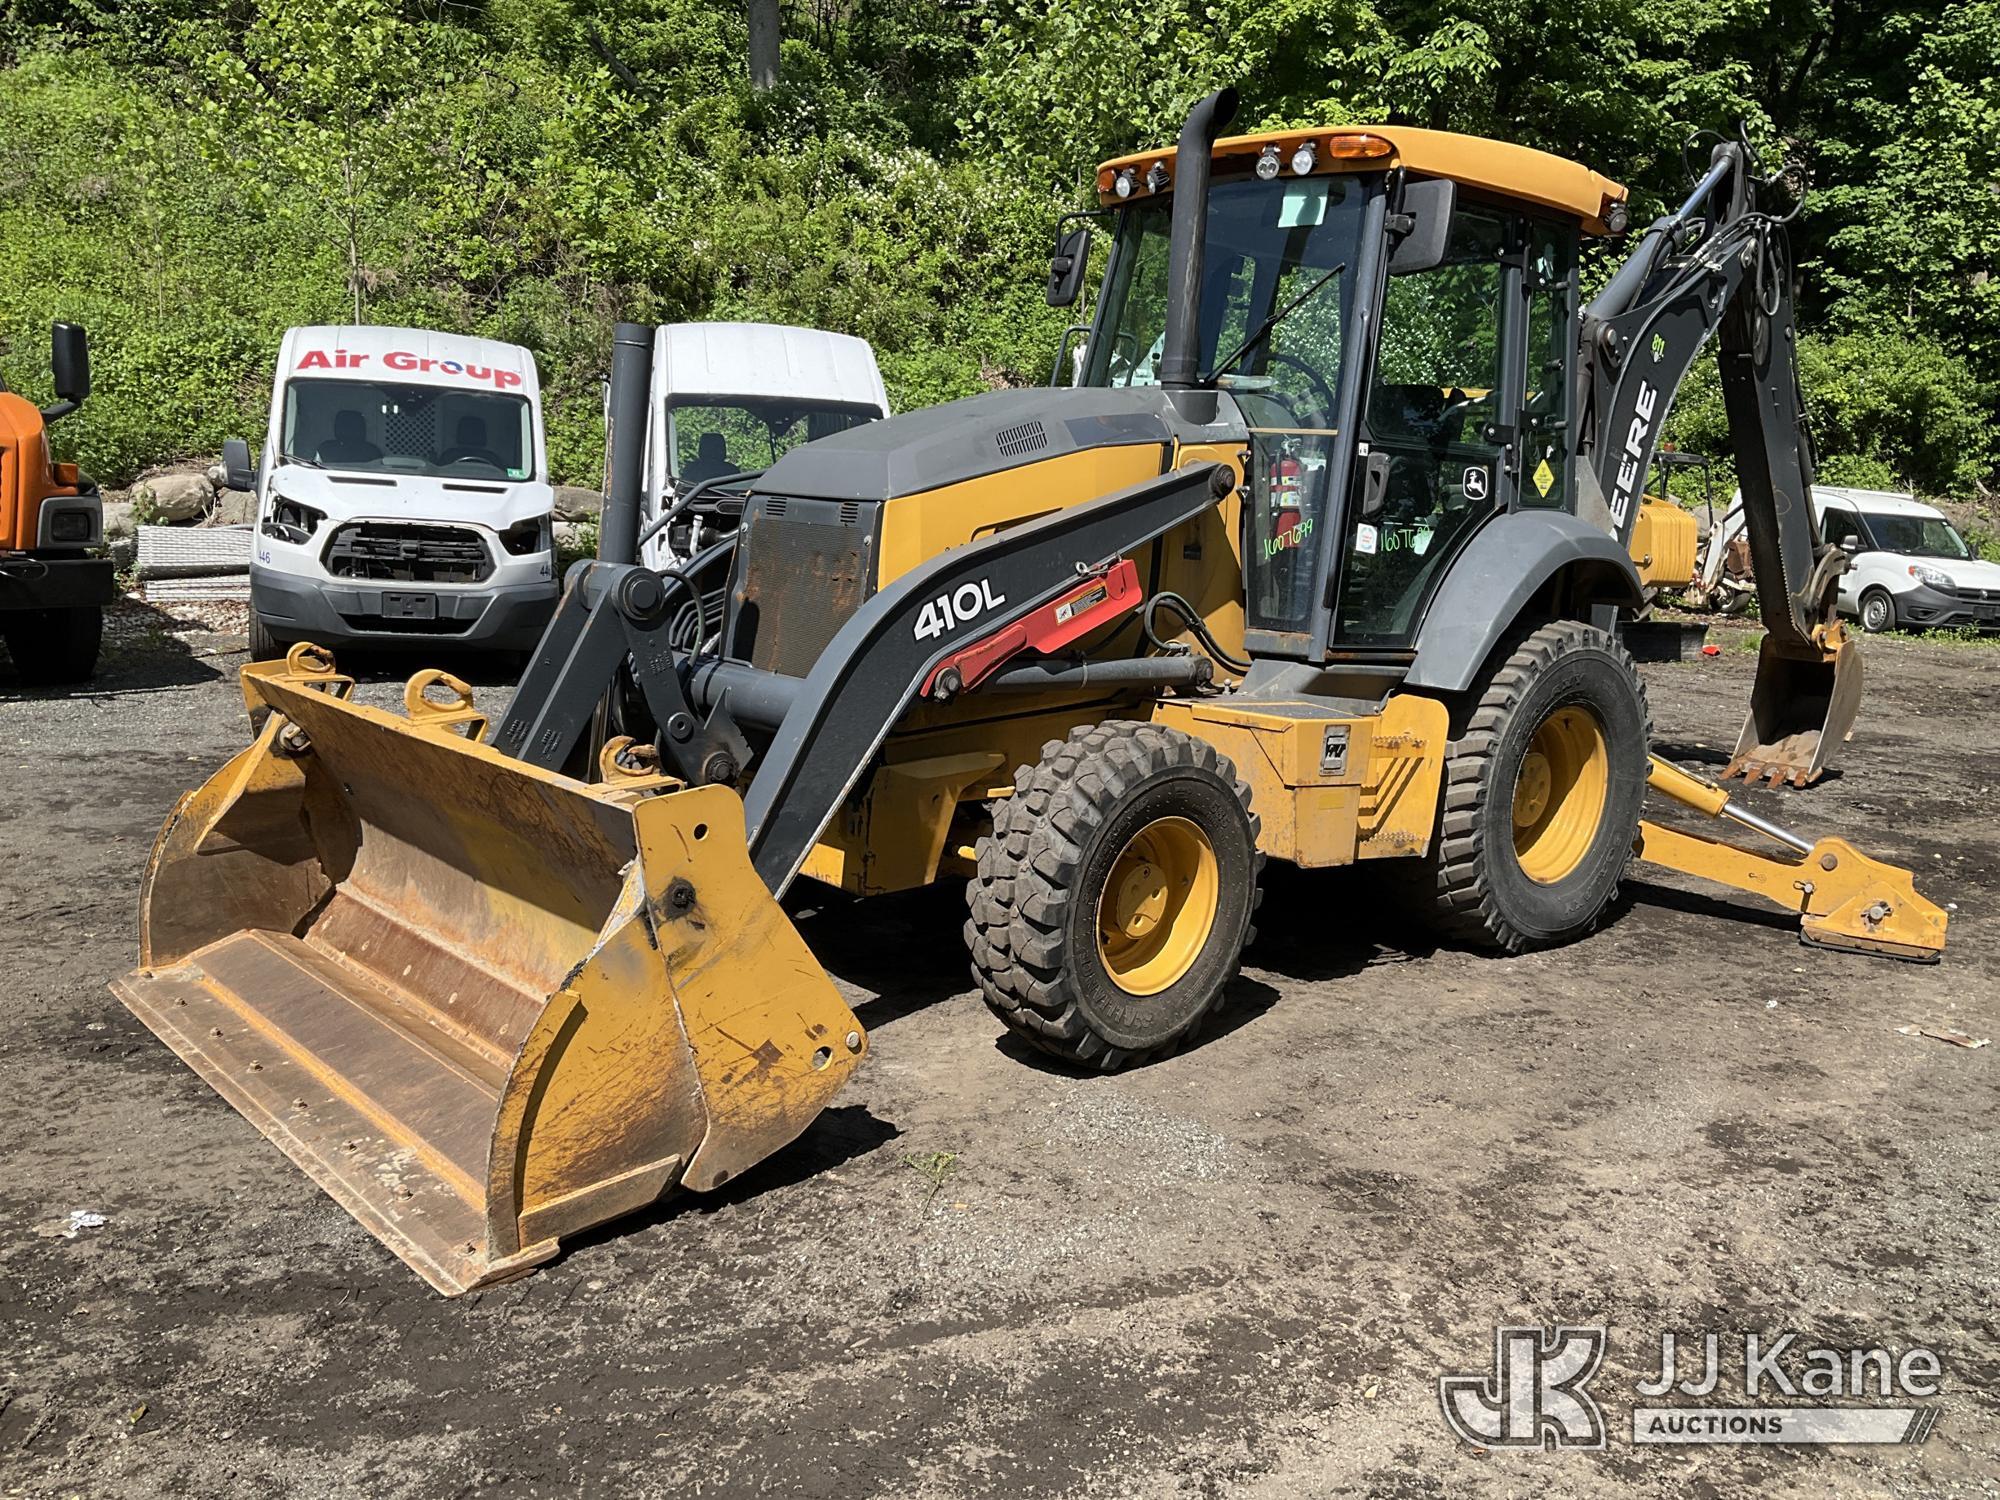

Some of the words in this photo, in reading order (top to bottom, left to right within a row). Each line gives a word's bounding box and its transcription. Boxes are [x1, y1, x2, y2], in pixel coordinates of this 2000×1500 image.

[297, 349, 369, 369] Air
[383, 351, 521, 388] Group
[914, 579, 1005, 640] 410L
